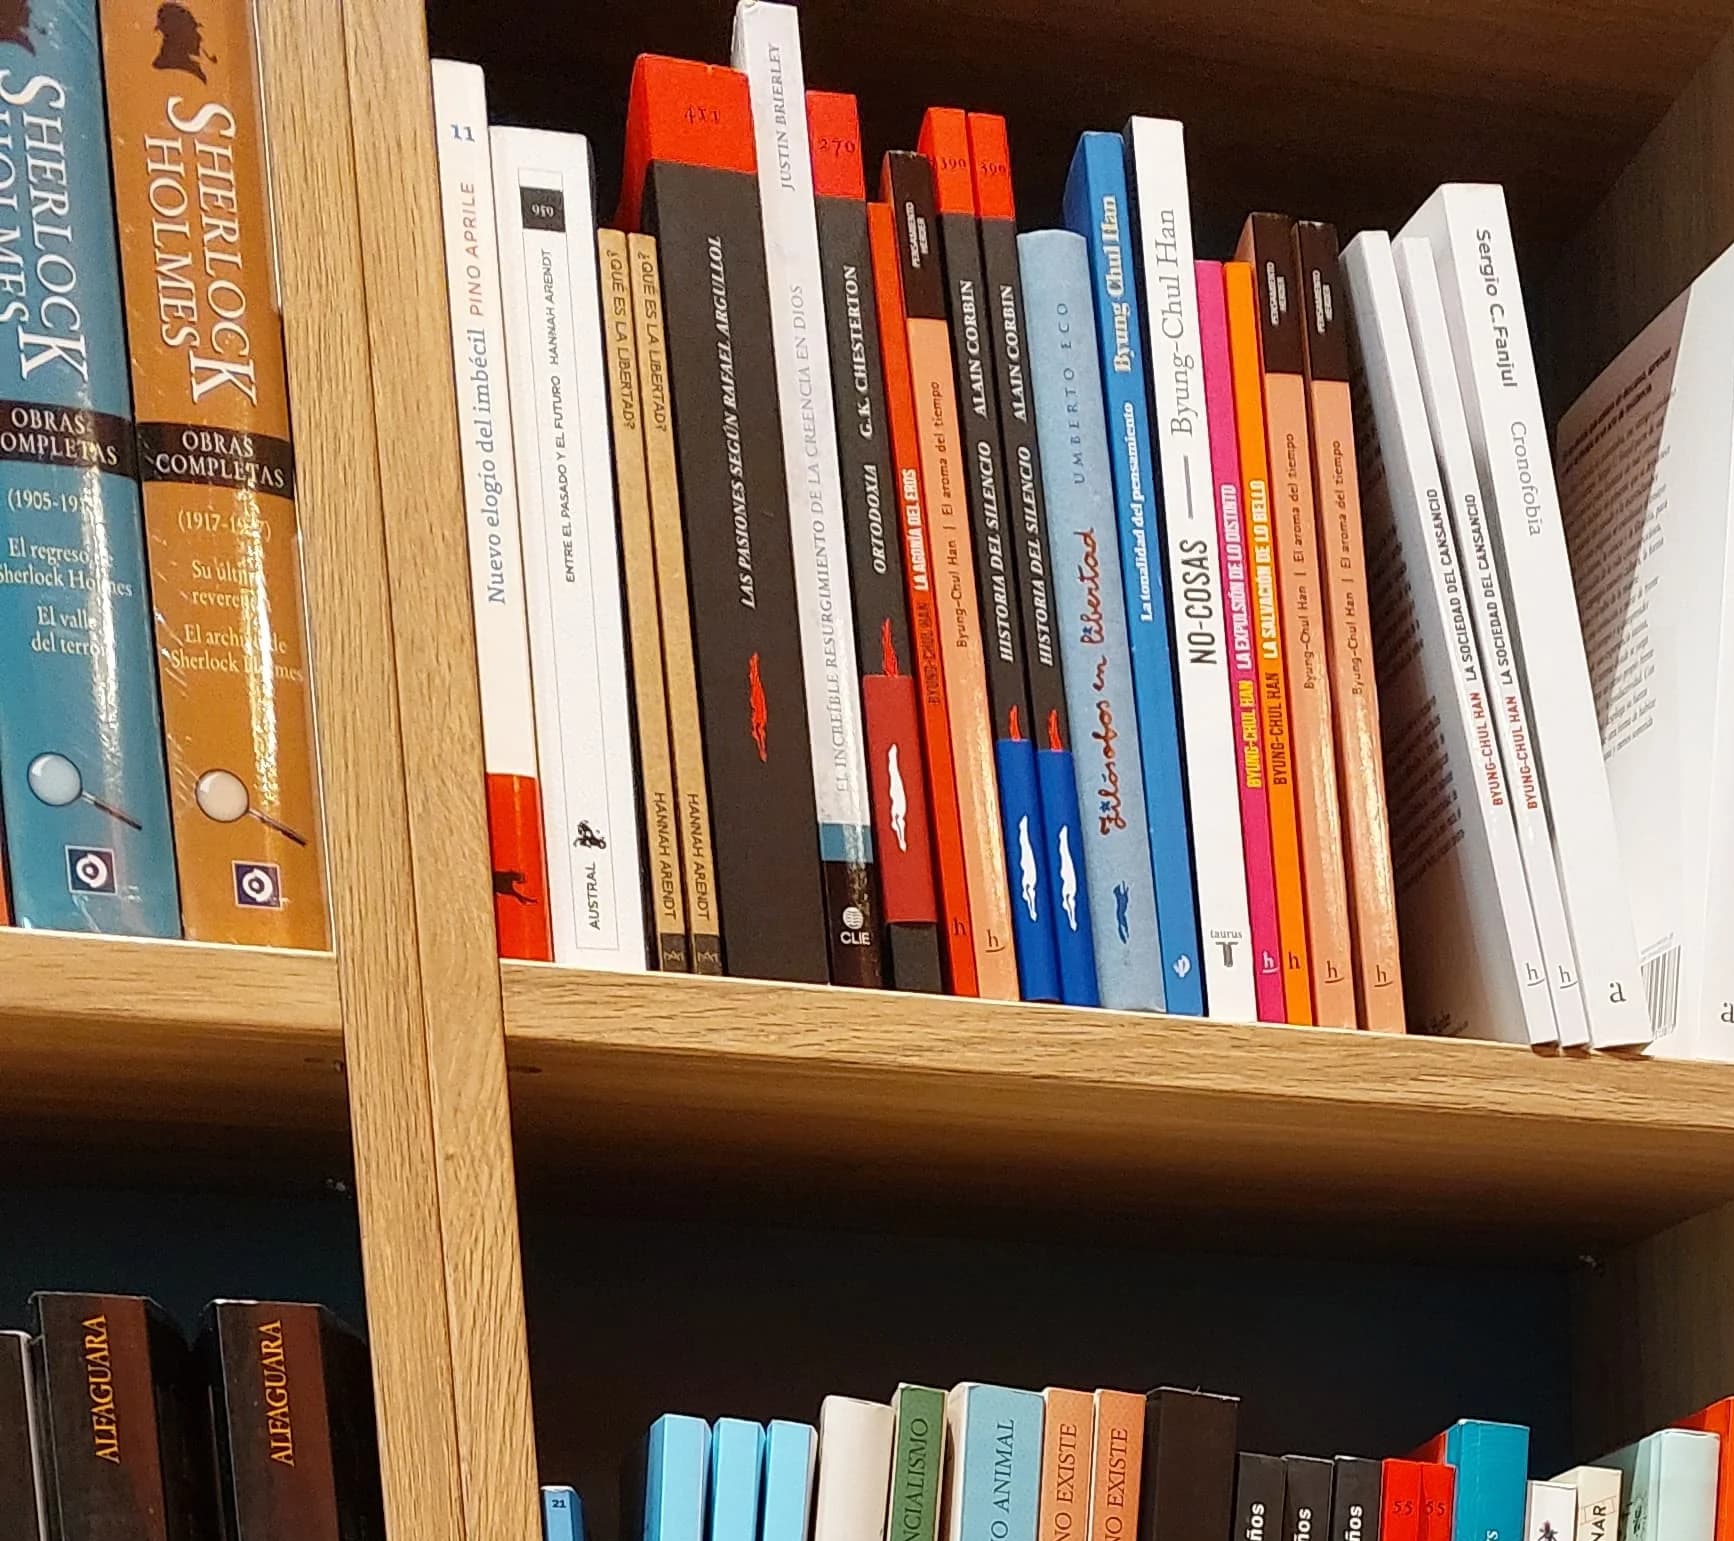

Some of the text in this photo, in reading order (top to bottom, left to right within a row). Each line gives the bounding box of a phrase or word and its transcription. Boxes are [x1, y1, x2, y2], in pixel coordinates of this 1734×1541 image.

[0, 69, 89, 382] SHERLOCK
[144, 133, 200, 350] HOLMES
[167, 96, 257, 406] SHERLOCK
[156, 453, 285, 488] COMPLETAS
[182, 430, 254, 458] OBRAS
[460, 182, 505, 604] Nuevo elogio del imbécil PINO APRILE
[843, 265, 886, 573] ORTODOXIA G.K. CHESTERTON
[1154, 209, 1216, 664] NO-COSAS Byung-Chul Han
[585, 862, 600, 930] AUSTRAL
[259, 1320, 294, 1466] ALFAGUARA
